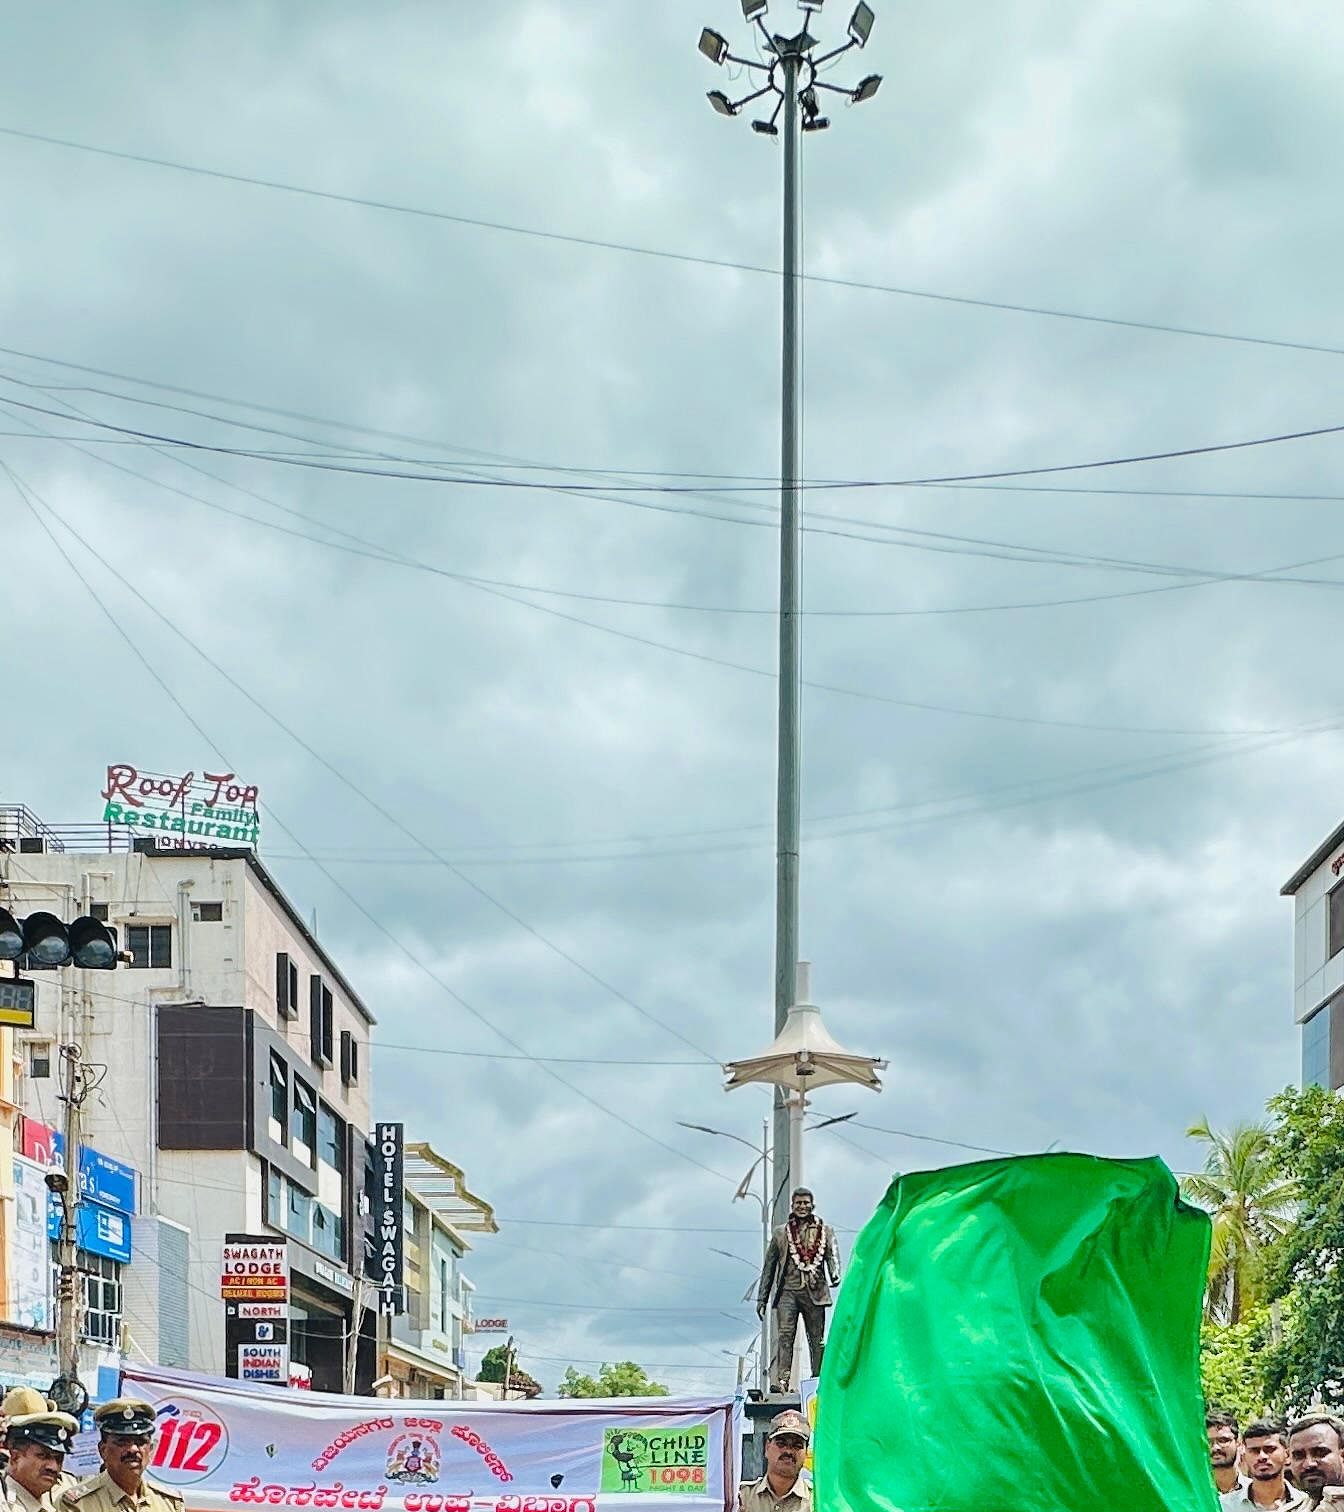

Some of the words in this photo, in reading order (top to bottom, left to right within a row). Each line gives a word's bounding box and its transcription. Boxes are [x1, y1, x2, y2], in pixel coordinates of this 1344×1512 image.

[101, 764, 194, 808] Roof
[203, 770, 258, 808] Top
[191, 802, 258, 826] Family
[103, 803, 260, 843] Restaurant
[381, 1125, 397, 1204] HOTEL
[223, 1248, 283, 1260] SWAGATH
[224, 1262, 282, 1275] LODGE
[380, 1209, 398, 1317] SWAGATH
[242, 1306, 281, 1317] NORTH
[475, 1319, 508, 1329] LODGE
[243, 1348, 281, 1358] SOUTH
[242, 1358, 281, 1369] INDIAN
[243, 1369, 280, 1380] DISHES
[151, 1418, 223, 1473] 112
[311, 1415, 395, 1472] ವಿಜಯನಗರ
[649, 1434, 707, 1451] CHILD
[650, 1450, 707, 1464] LINE
[648, 1467, 706, 1485] 1098
[228, 1475, 388, 1511] ಹೊಸಪೇಟೆ
